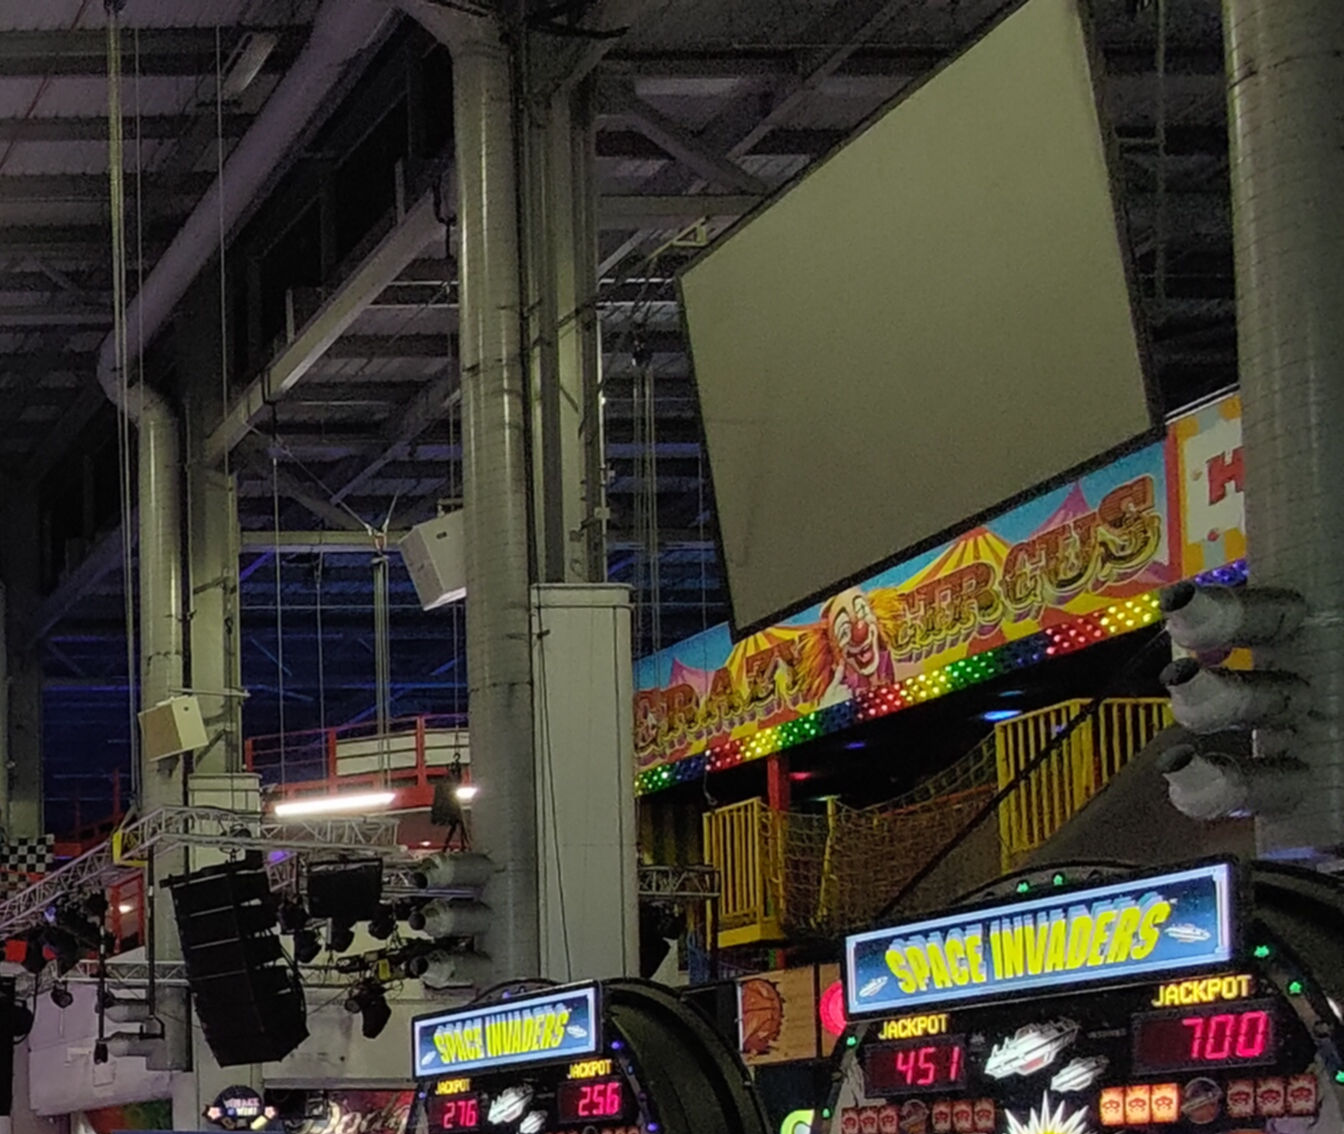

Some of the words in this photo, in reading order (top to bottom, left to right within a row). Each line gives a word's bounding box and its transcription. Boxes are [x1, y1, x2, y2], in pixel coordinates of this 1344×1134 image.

[885, 930, 985, 995] SPACE
[991, 897, 1174, 980] INVADERS
[1152, 975, 1252, 1008] JACKPOT
[433, 1021, 486, 1064] SPACE
[486, 1006, 571, 1057] INVADERS
[878, 1014, 949, 1041] JACKPOT
[1182, 1011, 1271, 1061] 700
[567, 1060, 612, 1079] JACKPOT
[895, 1046, 962, 1087] 451
[435, 1078, 471, 1095] JACKPOT
[578, 1082, 621, 1117] 256
[444, 1100, 478, 1128] 276
